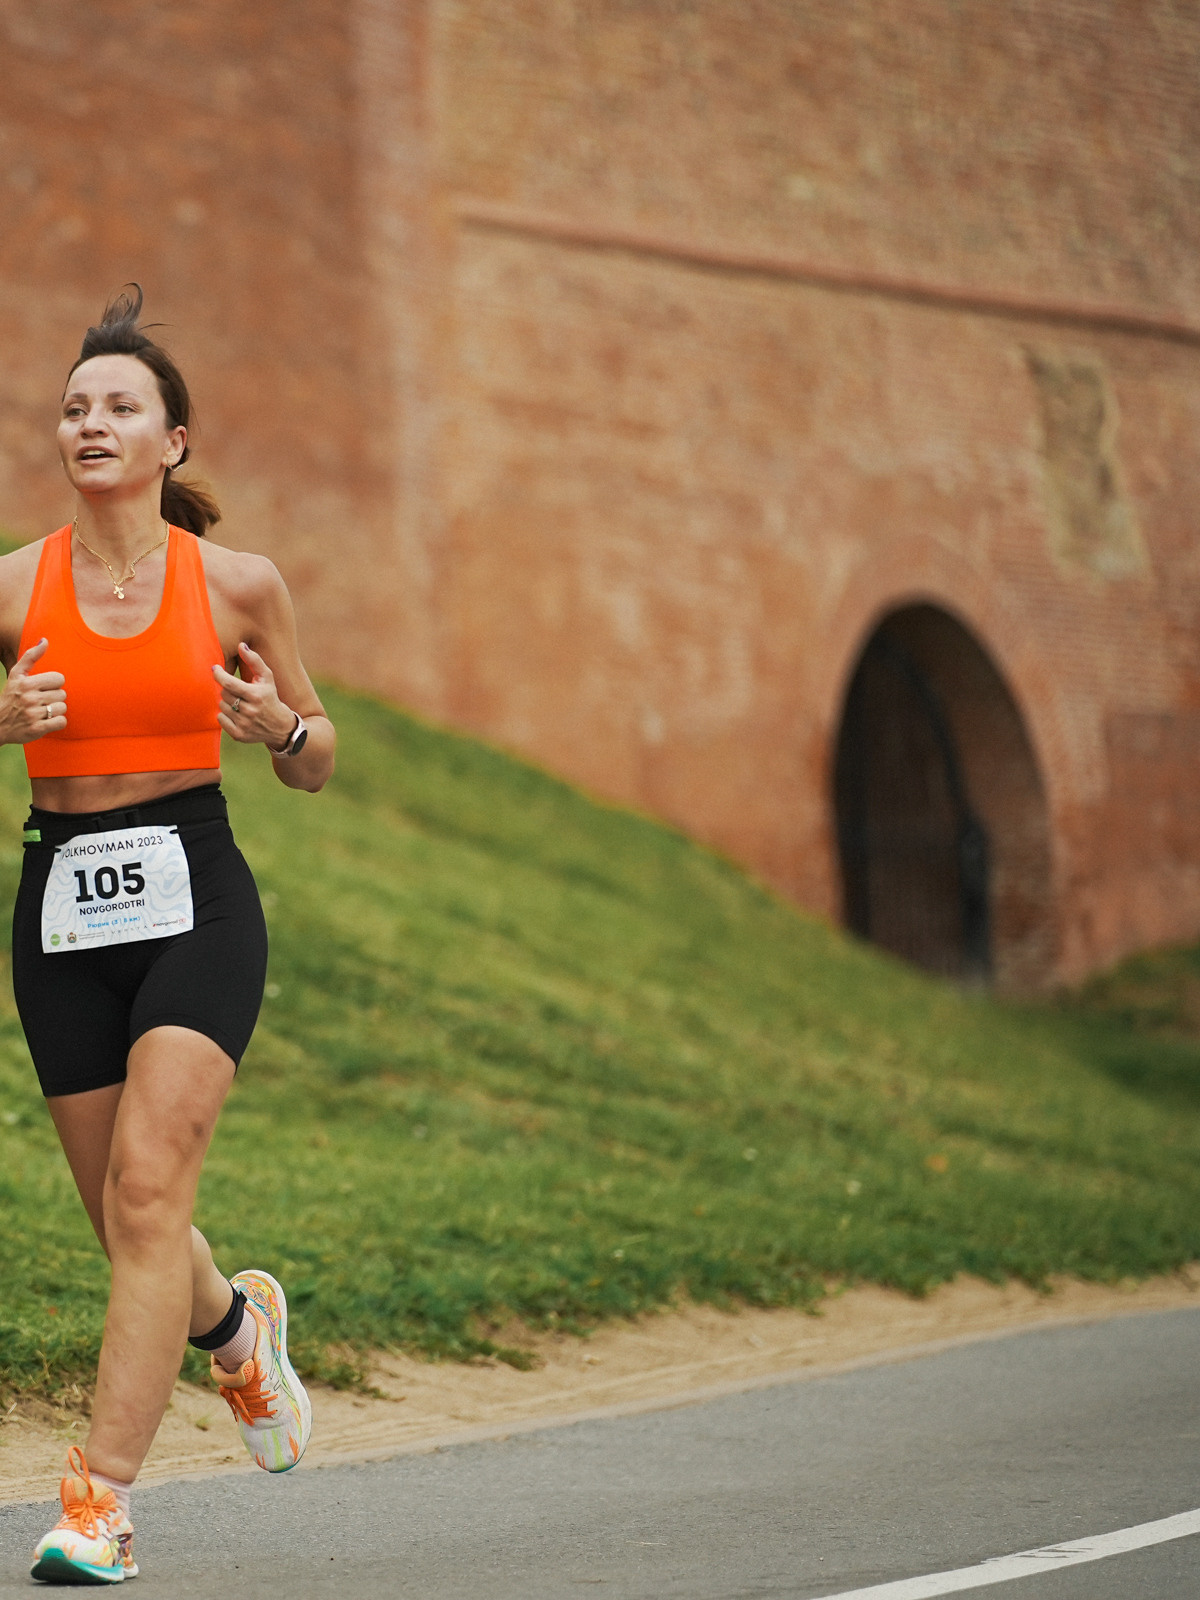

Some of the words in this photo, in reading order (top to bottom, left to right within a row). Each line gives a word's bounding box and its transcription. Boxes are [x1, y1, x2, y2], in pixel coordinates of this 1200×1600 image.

[137, 835, 164, 848] 2023
[73, 861, 146, 904] 105
[79, 898, 145, 916] NOVGORODTRI
